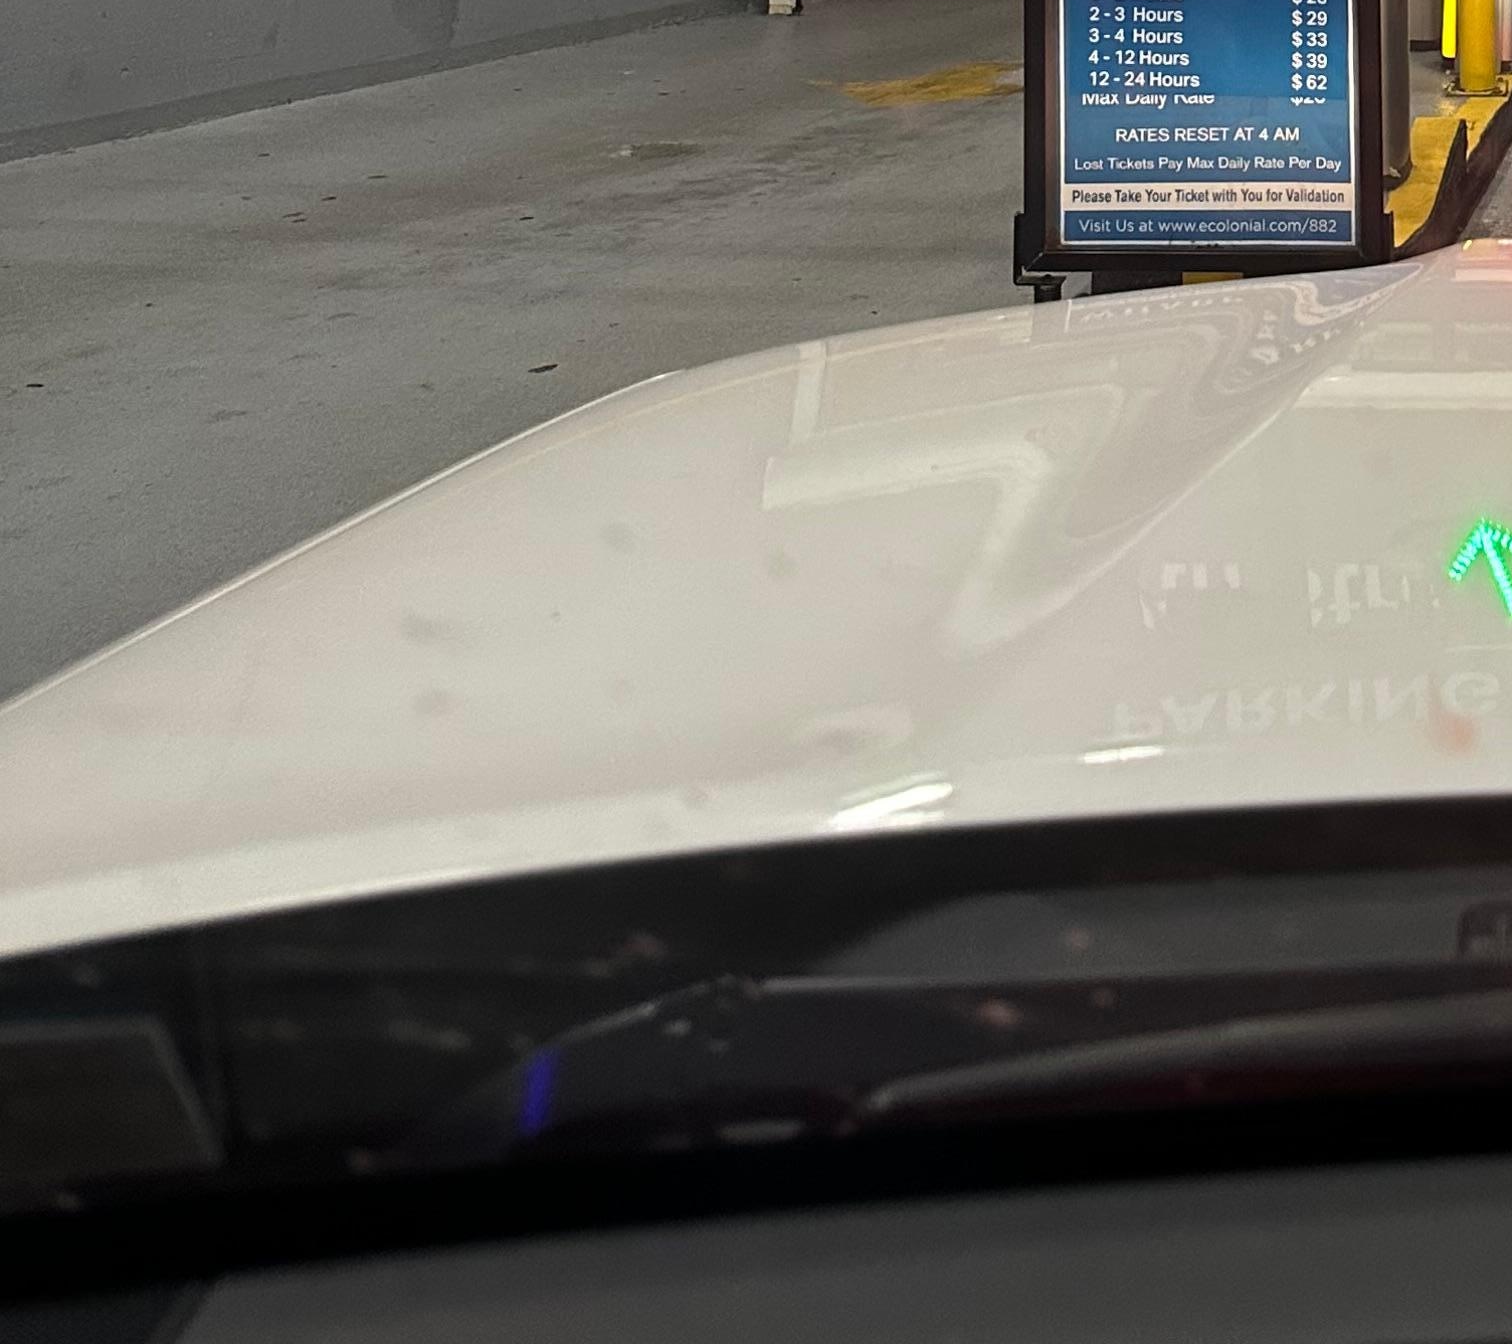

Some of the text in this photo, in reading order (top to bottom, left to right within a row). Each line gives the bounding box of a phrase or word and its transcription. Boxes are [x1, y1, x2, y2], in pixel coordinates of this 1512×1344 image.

[1089, 6, 1100, 21] 2
[1115, 6, 1125, 22] 3
[1133, 6, 1184, 22] Hours
[1292, 9, 1328, 27] $ 29
[1089, 28, 1099, 43] 3
[1114, 28, 1125, 43] 4
[1133, 28, 1183, 44] Hours
[1292, 30, 1328, 48] $ 33
[1088, 50, 1099, 64] 4
[1115, 50, 1135, 65] 12
[1139, 50, 1190, 66] Hours
[1292, 51, 1328, 69] $ 39
[1090, 71, 1109, 86] 12
[1124, 71, 1145, 86] 24
[1150, 71, 1200, 87] Hours
[1291, 73, 1328, 91] $ 62
[1082, 93, 1119, 105] Max
[1115, 127, 1300, 142] RATES RESET AT 4 AM
[1074, 156, 1342, 172] Lost Tickets Pay Max Daily Rate Per Day
[1072, 188, 1344, 203] Please Take Your Ticket with You for Validation
[1079, 217, 1337, 234] Visit Us at www.ecolonial.com/882
